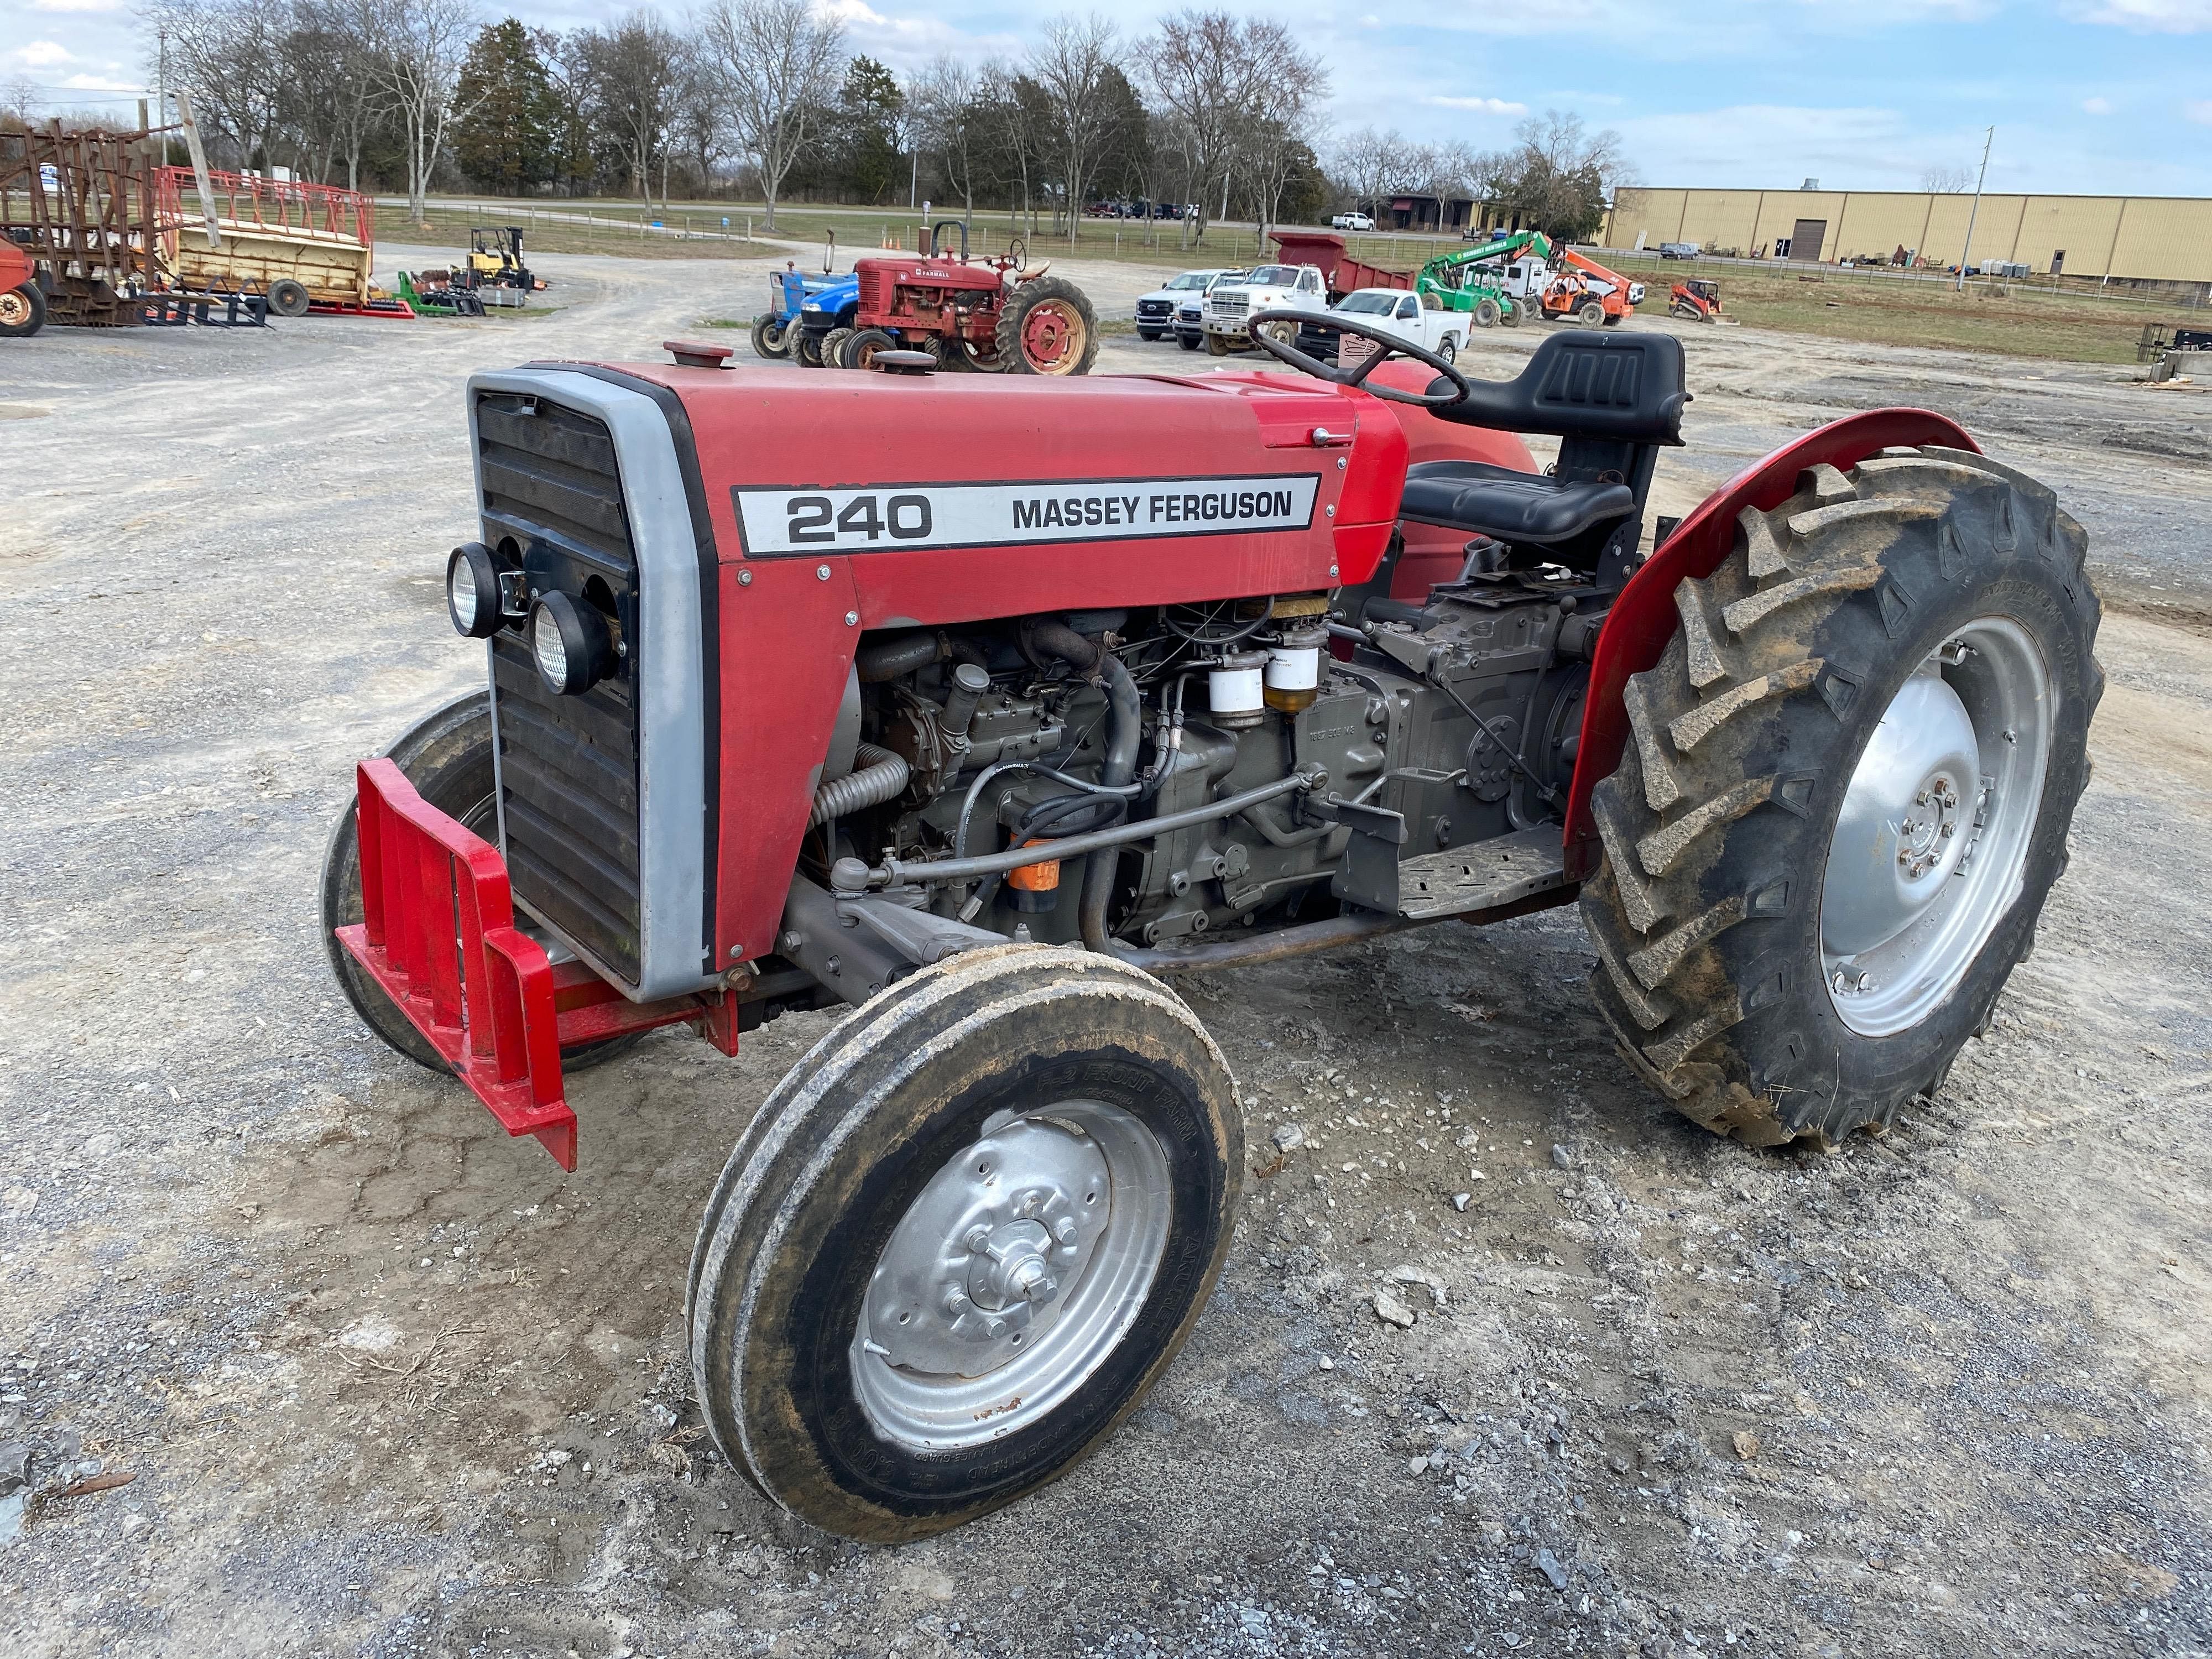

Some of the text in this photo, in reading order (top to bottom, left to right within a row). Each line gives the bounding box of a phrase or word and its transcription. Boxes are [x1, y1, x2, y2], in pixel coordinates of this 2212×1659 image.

[787, 491, 1291, 544] 240 MASSEY FERGUSON
[1083, 1063, 1155, 1093] FRONT
[1155, 1087, 1197, 1142] FARM
